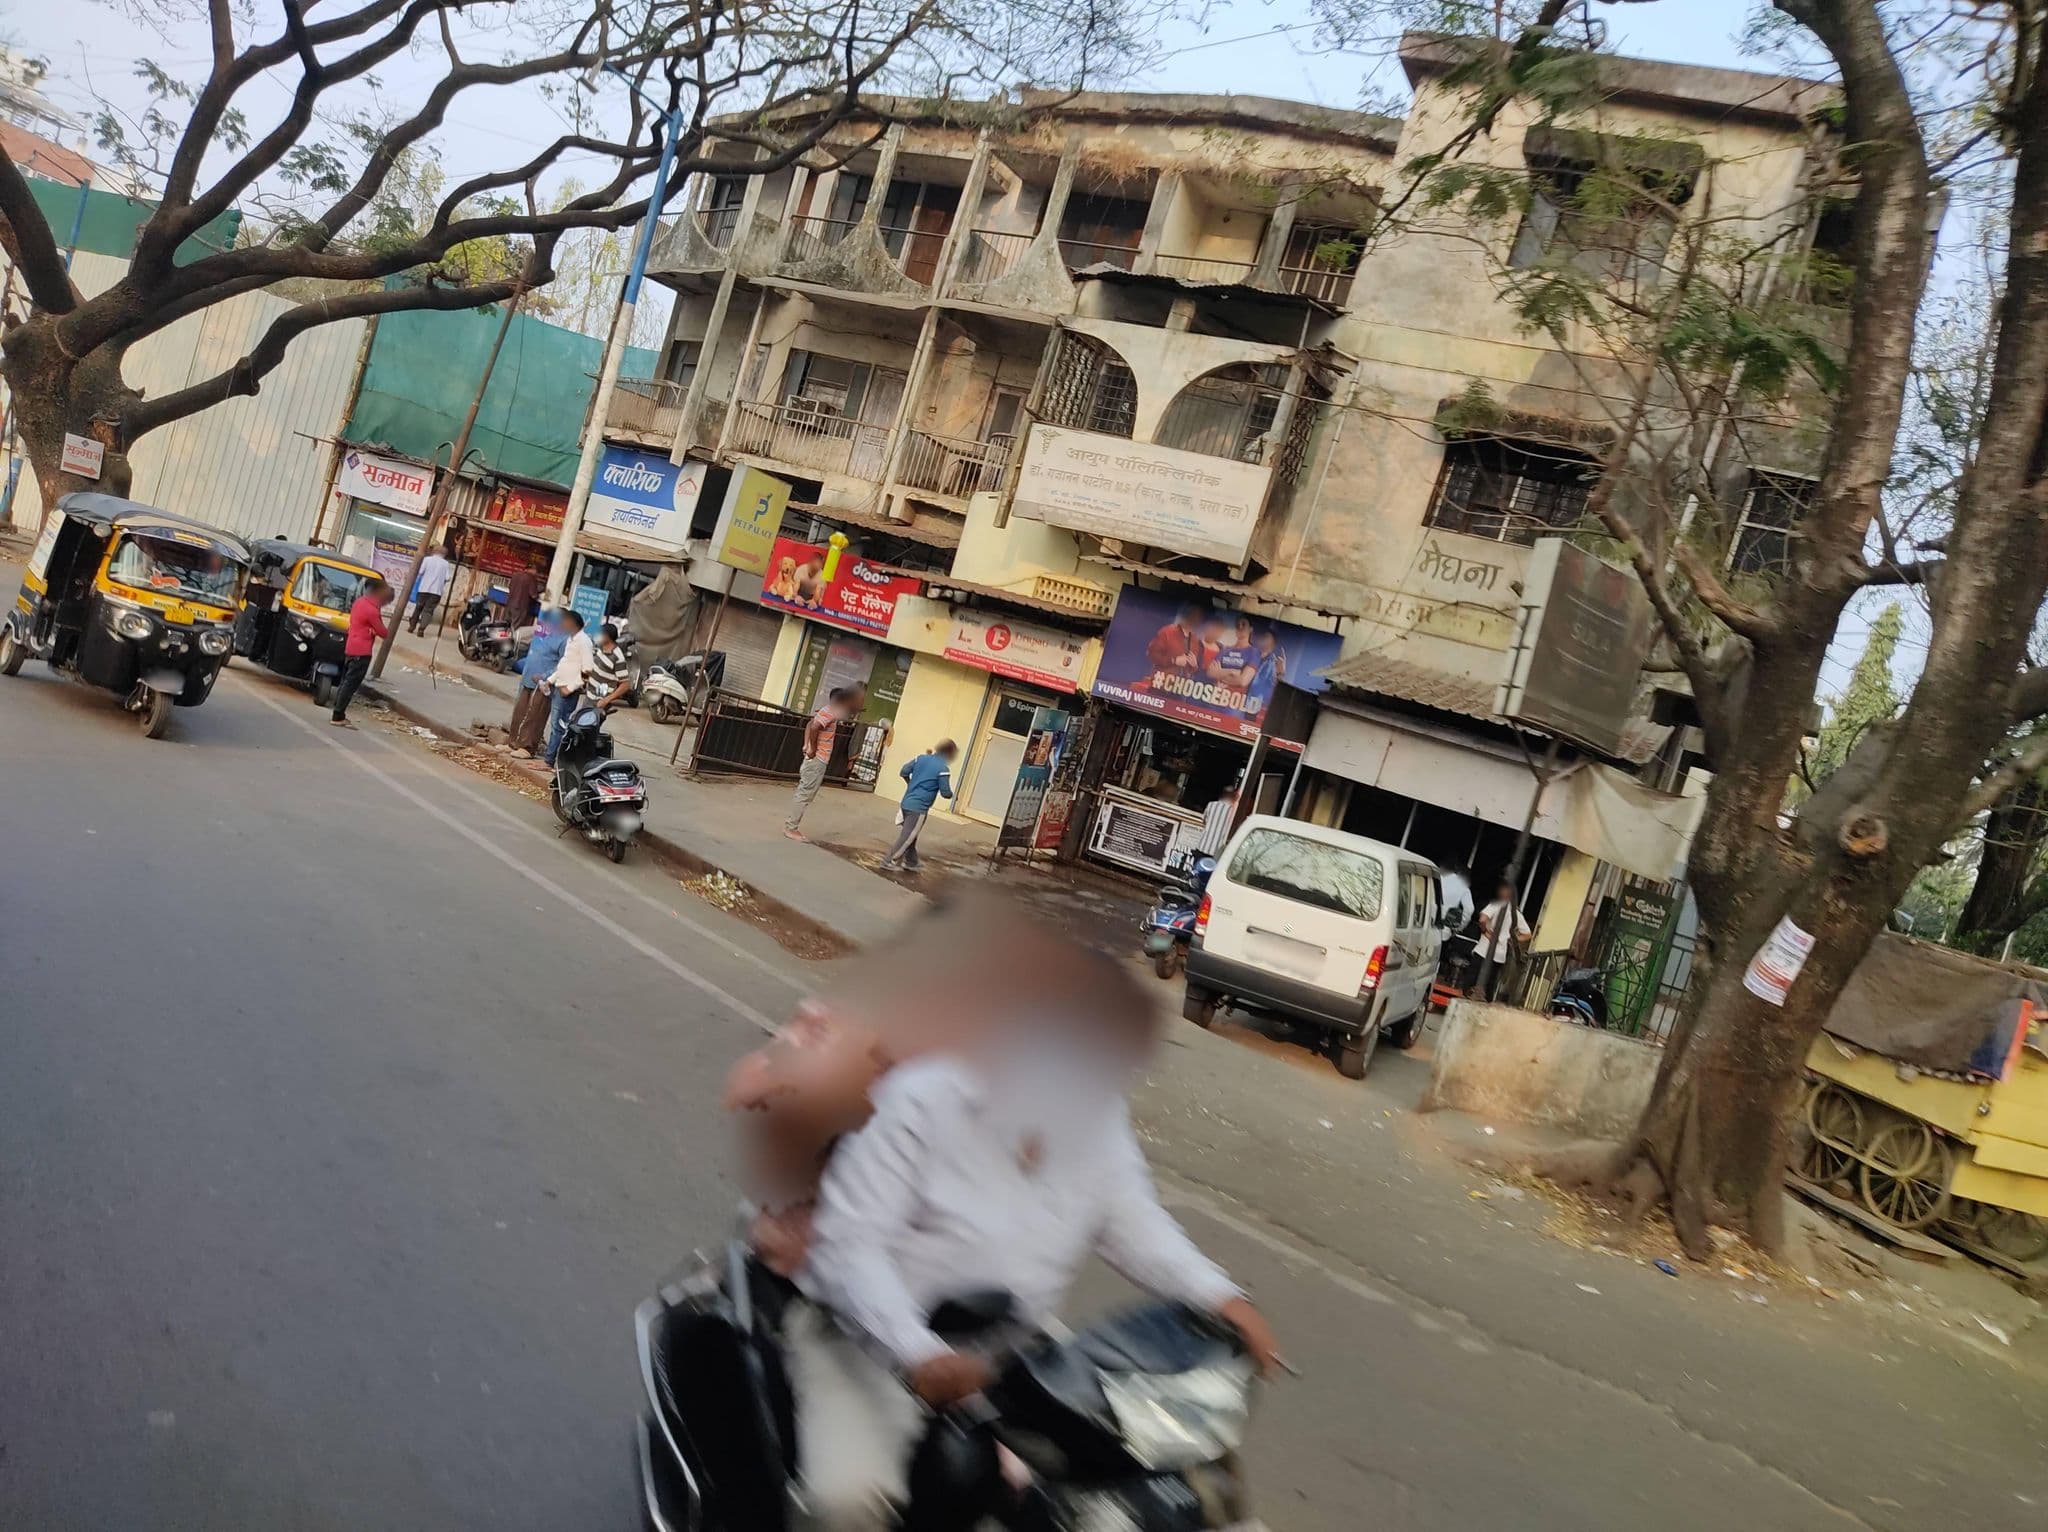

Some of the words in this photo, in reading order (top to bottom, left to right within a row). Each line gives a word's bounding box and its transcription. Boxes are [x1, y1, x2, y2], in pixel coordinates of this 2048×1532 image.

[65, 443, 100, 461] सन्मान
[362, 462, 424, 495] सन्मान
[603, 462, 665, 493] क्लासिक
[1082, 472, 1112, 492] पाटील
[733, 518, 748, 530] PET
[748, 522, 773, 539] PALACE
[1419, 539, 1503, 591] मेघना
[840, 586, 861, 605] पेट
[862, 592, 894, 615] पॅलेस
[843, 604, 858, 616] PET
[857, 607, 883, 621] PALACE
[1098, 682, 1132, 701] YUVRAJ
[1134, 691, 1166, 709] WINES
[1152, 671, 1262, 714] #CHOOSEBOLD
[1016, 700, 1037, 713] Epiro
